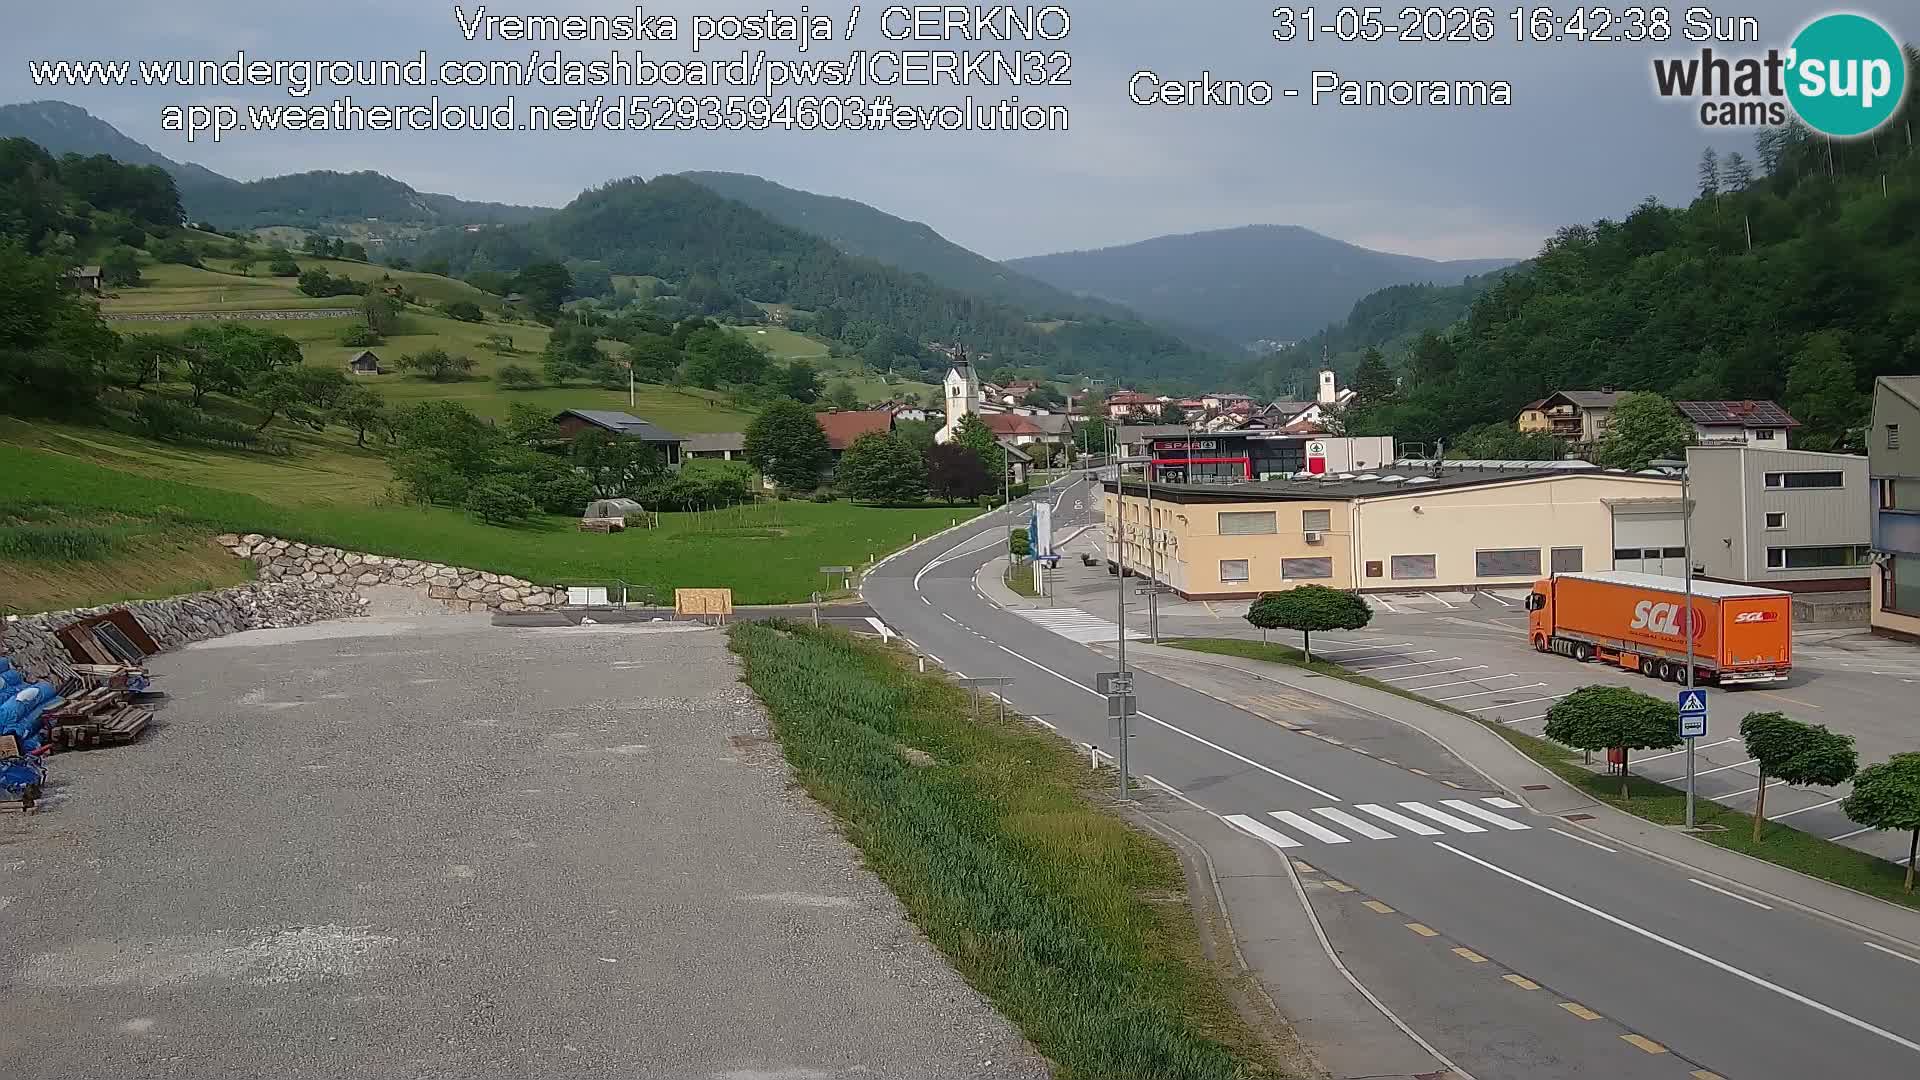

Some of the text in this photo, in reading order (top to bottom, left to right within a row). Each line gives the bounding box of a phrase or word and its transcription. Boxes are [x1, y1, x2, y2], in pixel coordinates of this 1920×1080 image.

[1163, 441, 1201, 449] SPAR
[1631, 600, 1680, 635] SGL
[1735, 612, 1763, 623] SGL
